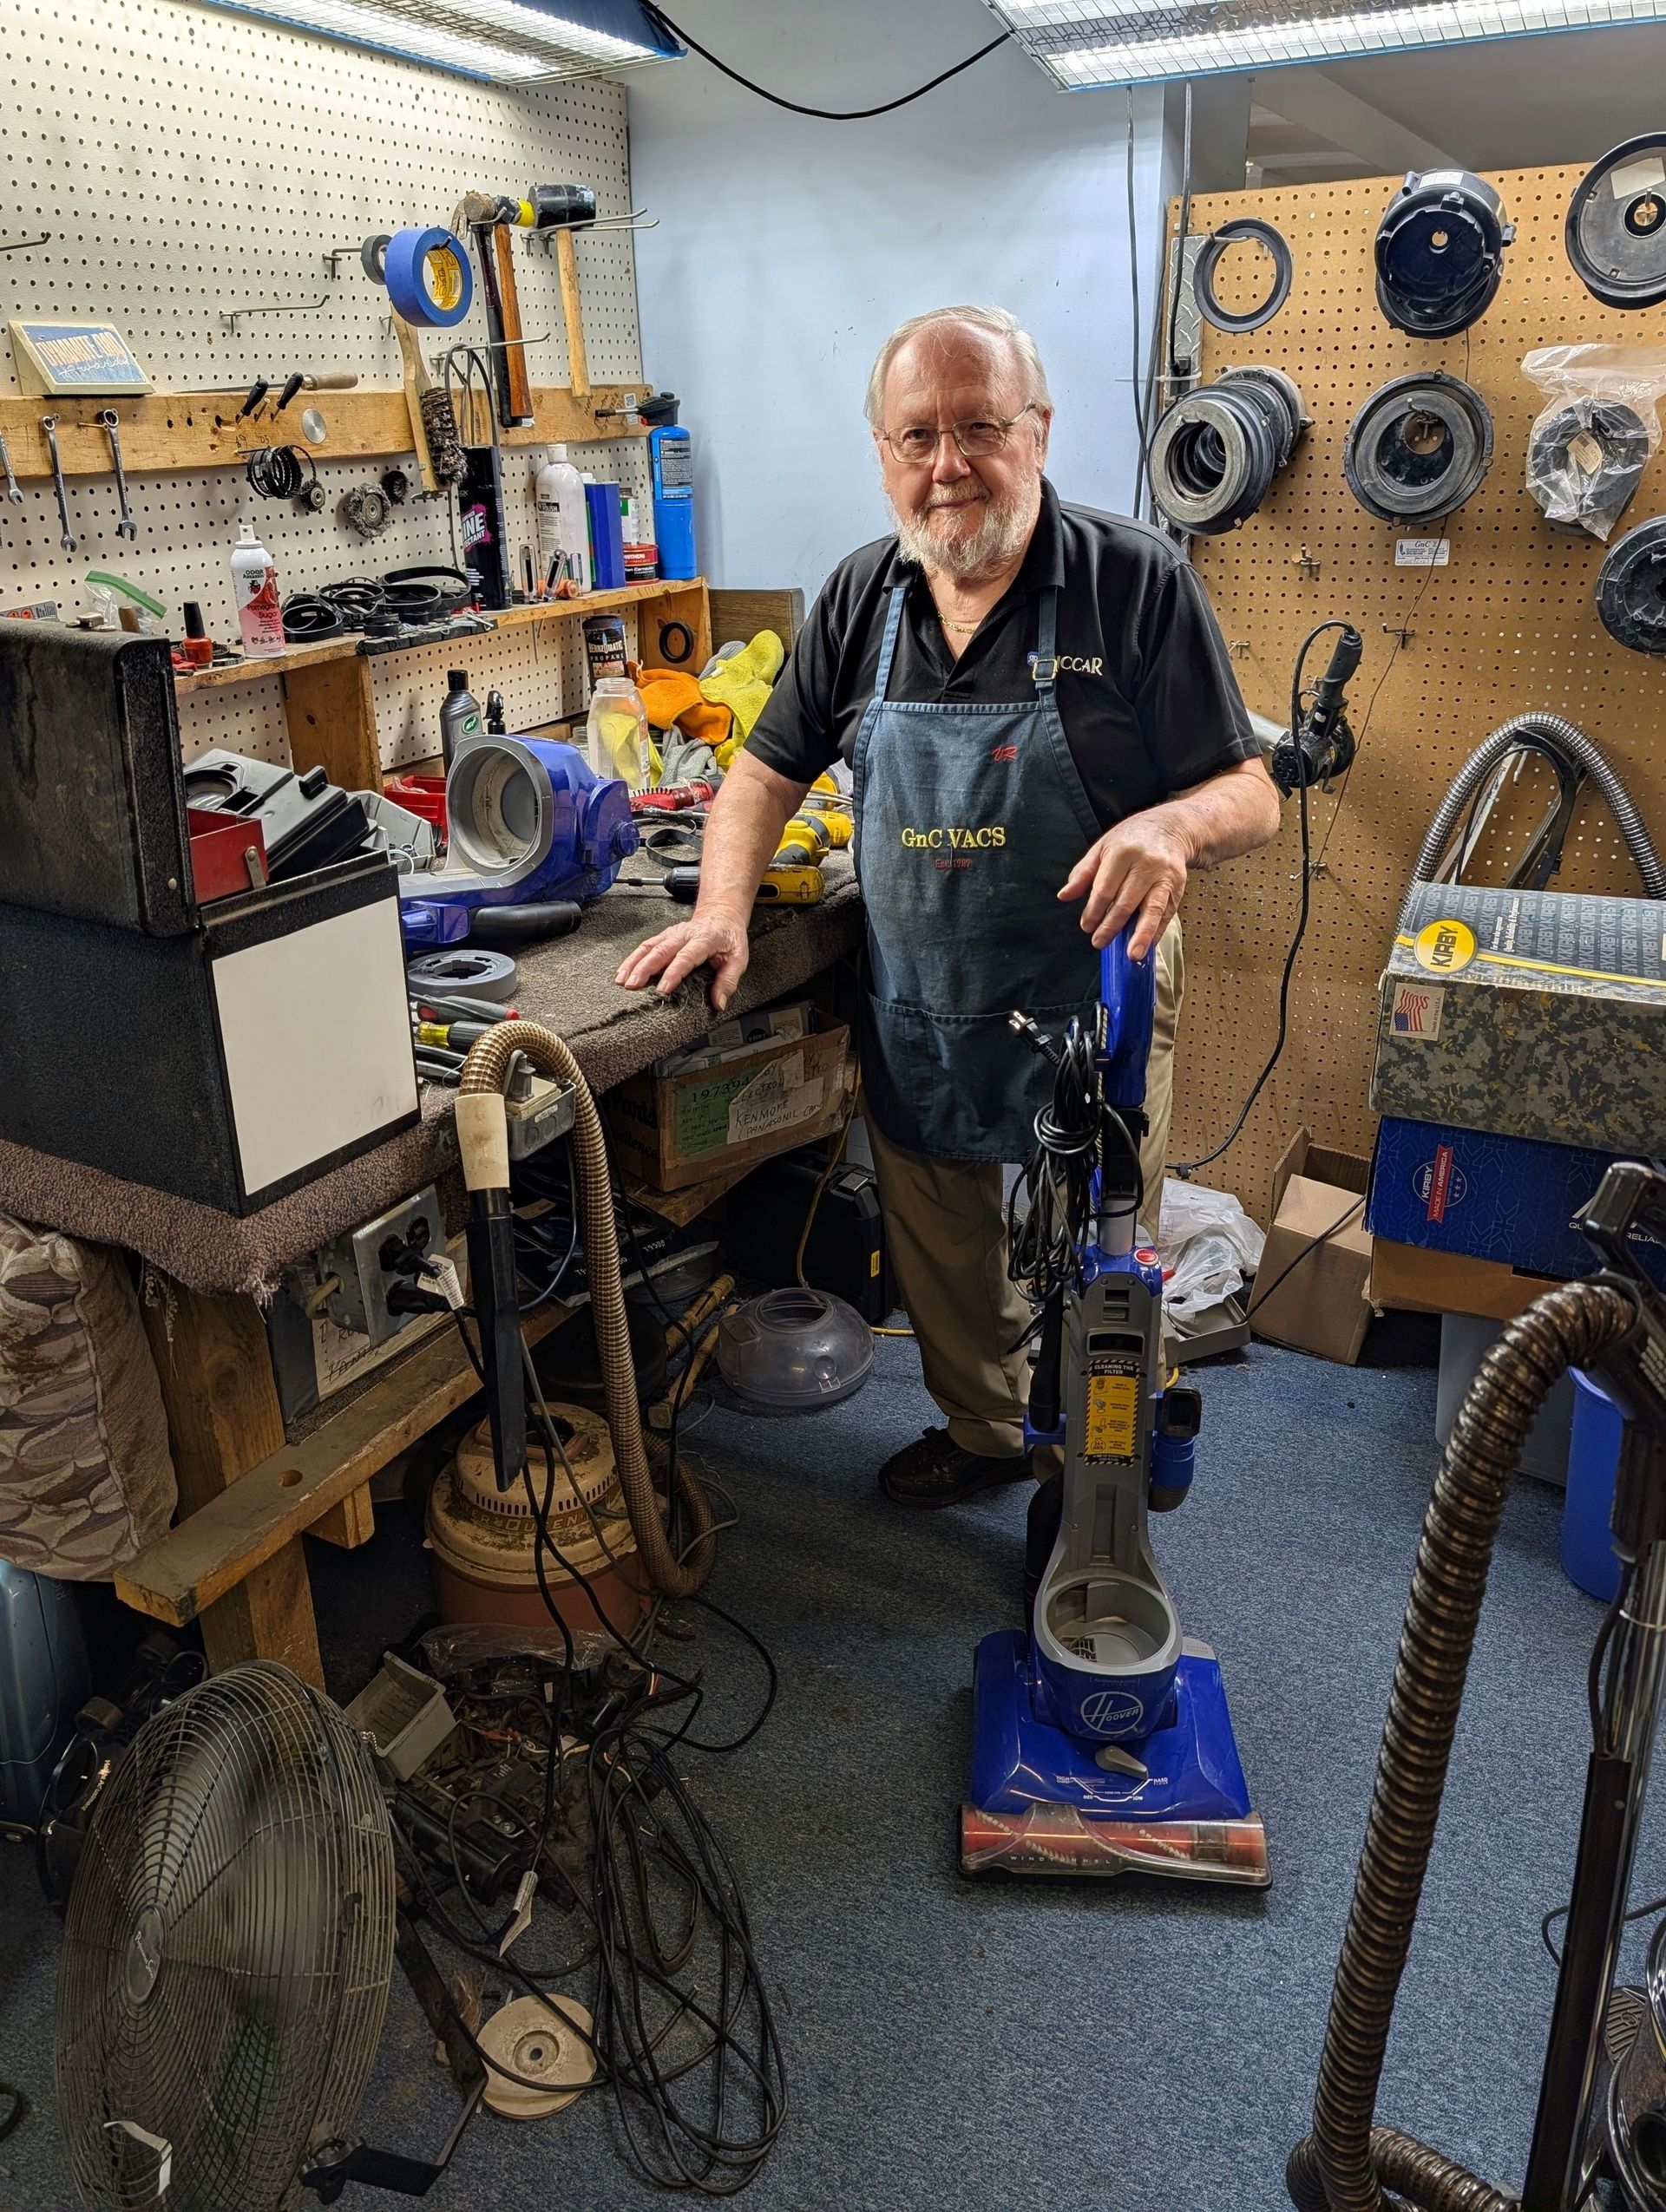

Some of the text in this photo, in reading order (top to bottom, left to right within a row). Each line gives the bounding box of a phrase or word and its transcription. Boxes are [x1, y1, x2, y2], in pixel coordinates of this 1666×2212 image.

[462, 512, 485, 540] INE
[1057, 656, 1103, 676] ICCAR
[902, 827, 1006, 848] GnC VACS
[1430, 925, 1459, 967] KIRBY
[1421, 1166, 1433, 1198] KIRBY
[1433, 1196, 1441, 1217] MADE
[1438, 1151, 1447, 1187] AMERICA
[506, 1514, 578, 1532] QUEN
[1086, 1692, 1140, 1730] HOOVER
[1010, 1855, 1110, 1864] WINDTUNNEL
